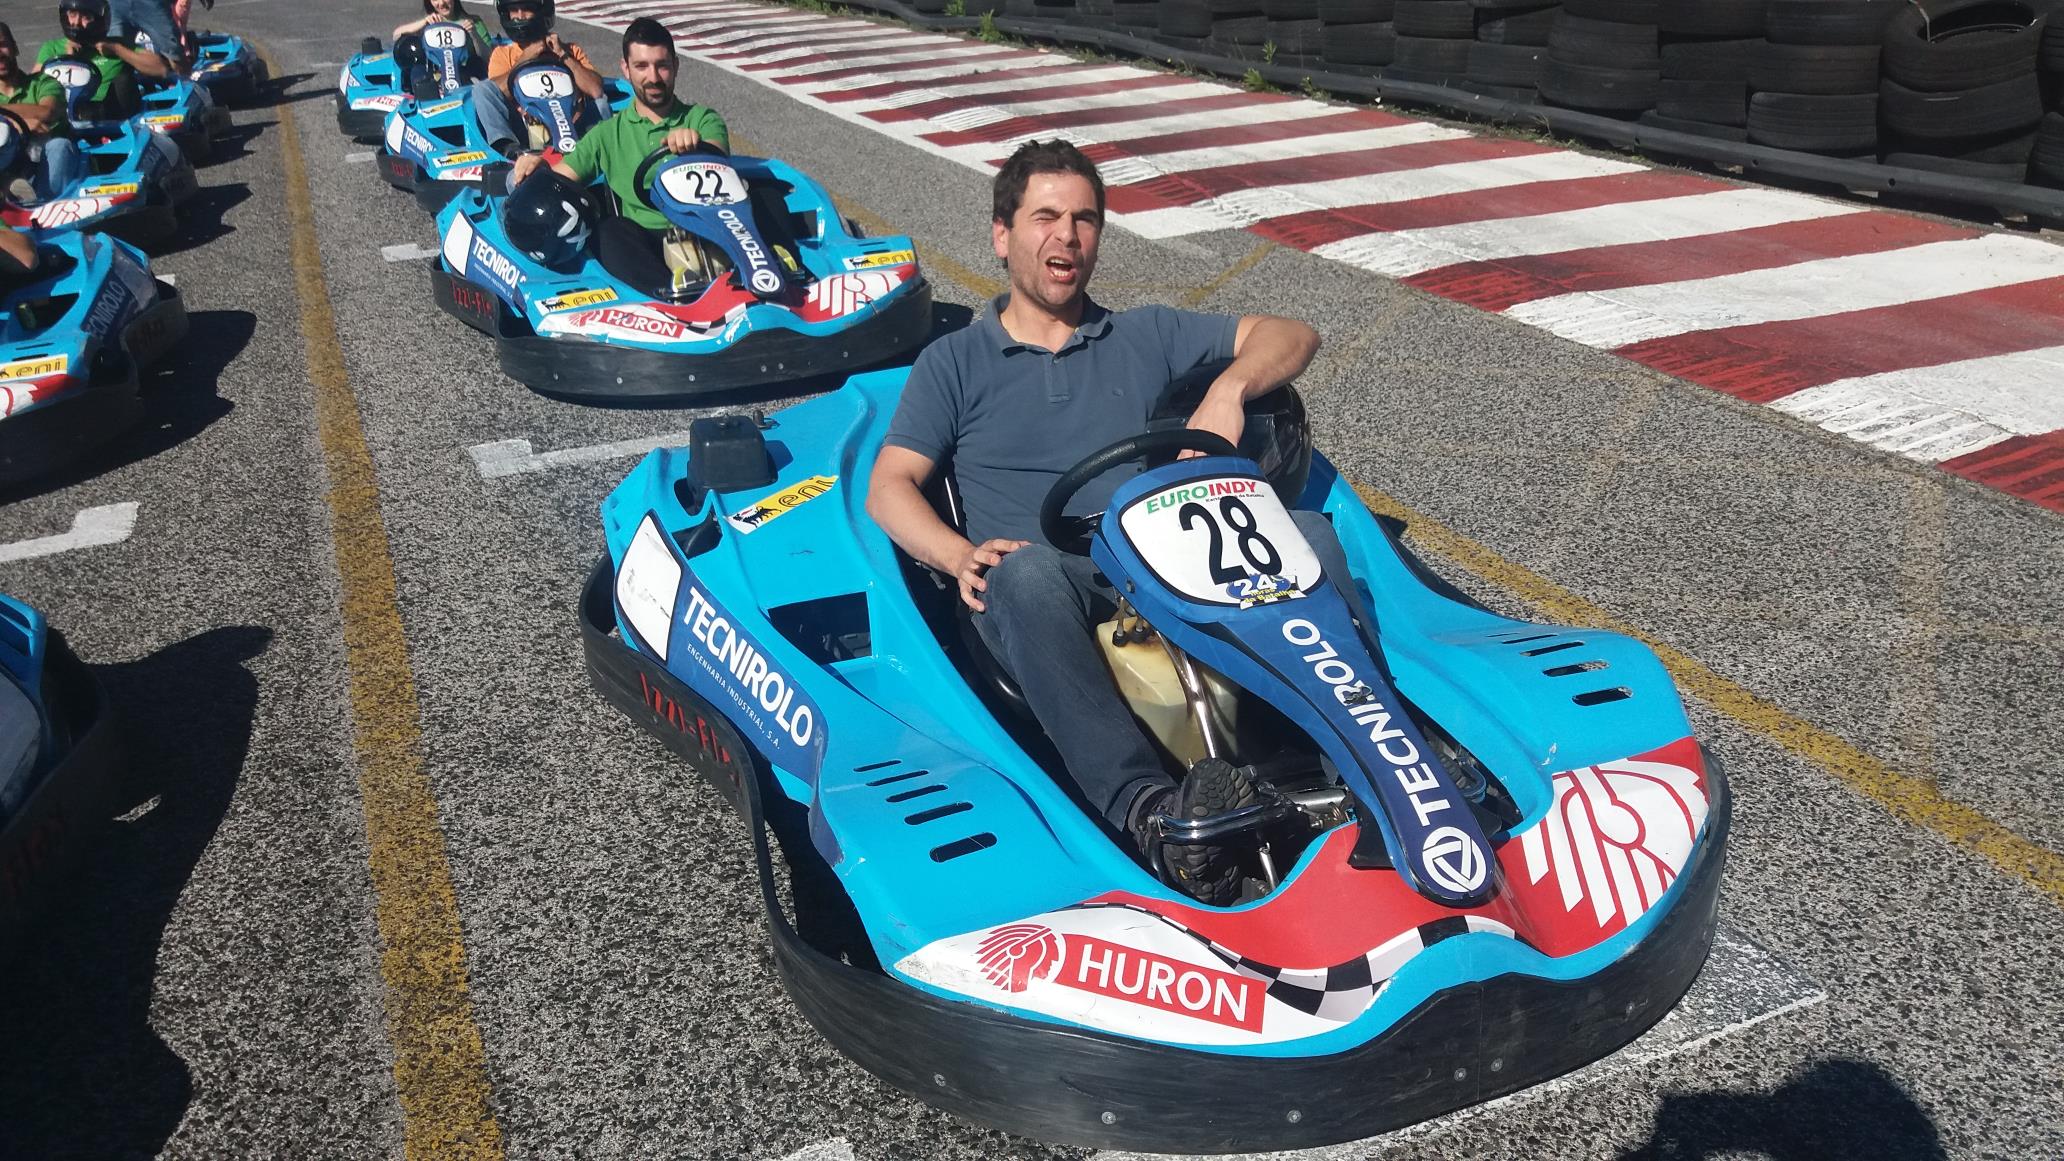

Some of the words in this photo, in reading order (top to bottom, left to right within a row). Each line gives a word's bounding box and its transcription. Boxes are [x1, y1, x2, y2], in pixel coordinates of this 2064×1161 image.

[435, 30, 453, 45] 18
[540, 74, 554, 93] 9
[404, 125, 437, 153] TECNIRO
[672, 163, 728, 175] EUROINDY
[686, 169, 730, 199] 22
[717, 209, 768, 270] TECNIROLO
[573, 288, 614, 305] eni
[607, 310, 678, 337] HURON
[16, 358, 61, 377] eni
[778, 477, 835, 507] eni
[1146, 481, 1256, 514] EUROINDY
[1178, 496, 1282, 586] 28
[1234, 574, 1278, 596] 24
[682, 586, 813, 747] TECNIROLO
[687, 643, 726, 688] ENGENHARIA
[726, 685, 765, 734] INDUSTRIAL,
[766, 730, 781, 750] S.A.
[1282, 618, 1451, 827] TECNIROLO
[1077, 943, 1248, 1022] HURON
